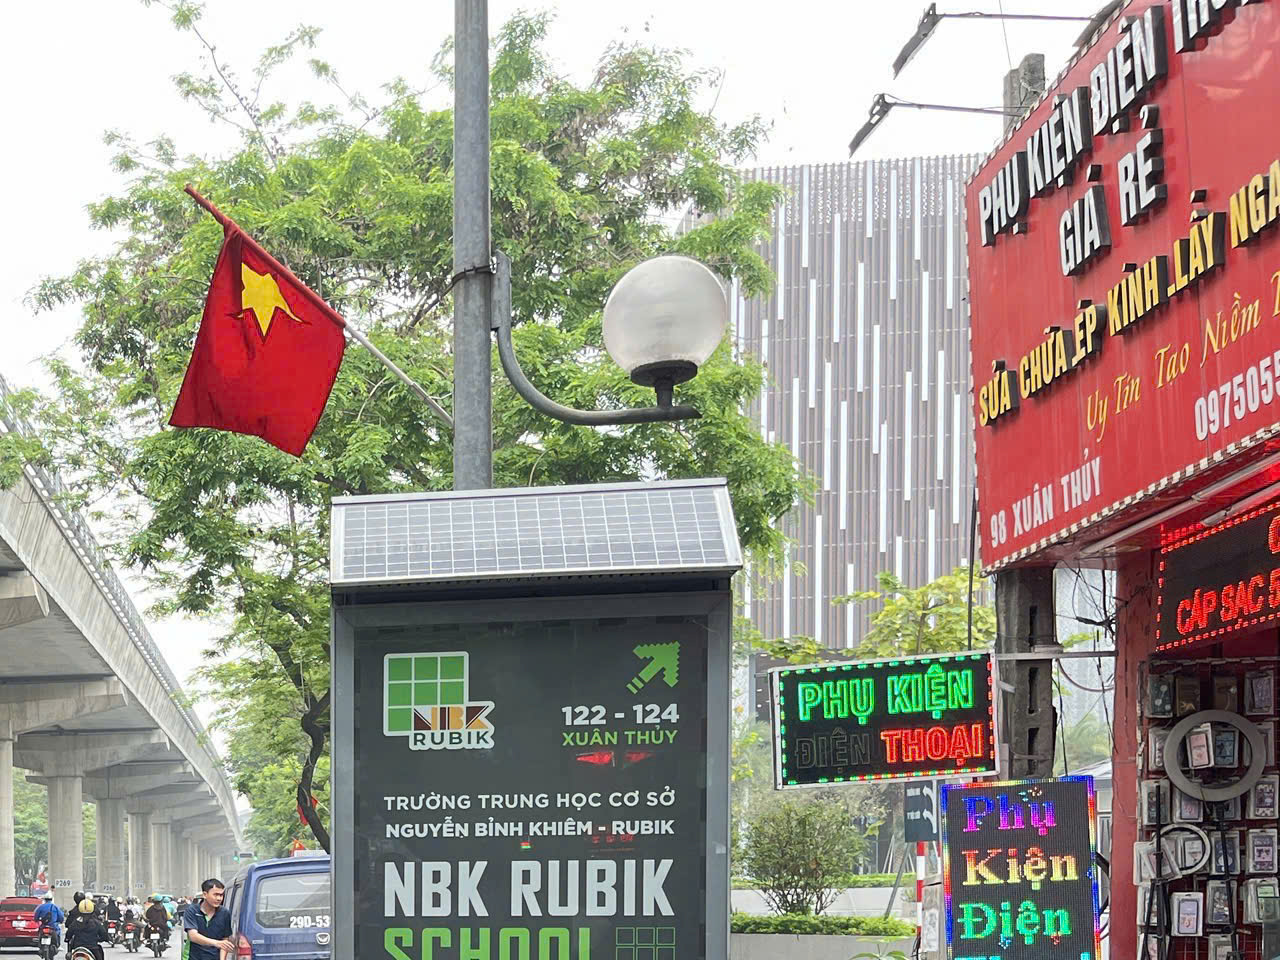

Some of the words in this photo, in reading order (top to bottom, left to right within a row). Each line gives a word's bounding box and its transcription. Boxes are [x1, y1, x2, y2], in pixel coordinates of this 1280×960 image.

[979, 153, 1020, 247] PHỤ
[1026, 86, 1087, 199] KIỆN
[1090, 5, 1157, 136] ĐIỆN
[1059, 165, 1101, 276] GIÁ
[1118, 104, 1157, 227] RẺ
[979, 361, 1012, 427] SỬA
[1020, 328, 1067, 399] CHỮA
[1108, 256, 1160, 336] KÍNH
[1087, 391, 1108, 443] Uy
[1114, 371, 1141, 415] Tín
[1155, 342, 1190, 389] Tạo
[1200, 292, 1261, 368] Niềm
[990, 510, 1007, 549] 98
[1012, 483, 1054, 538] XUÂN
[1061, 448, 1101, 512] THỦY
[1176, 589, 1217, 635] CÁP
[562, 705, 606, 726] 122
[632, 704, 679, 725] 124
[798, 678, 875, 726] PHỤ
[887, 664, 973, 720] KIỆN
[414, 731, 489, 745] RUBIK
[563, 729, 618, 746] XUÂN
[625, 725, 678, 745] THỦY
[795, 727, 871, 773] ĐIỆN
[880, 724, 984, 766] THOẠI
[384, 792, 471, 810] TRƯỜNG
[478, 794, 549, 809] TRUNG
[557, 793, 602, 811] HỌC
[609, 791, 640, 807] CƠ
[647, 785, 676, 807] SỞ
[962, 794, 1057, 836] Phụ
[385, 816, 469, 838] NGUYỄN
[529, 817, 593, 837] KHIÊM
[612, 819, 675, 836] RUBIK
[56, 879, 71, 887] P269
[384, 860, 489, 917] NBK
[511, 859, 675, 917] RUBIK
[962, 848, 1078, 890] Kiện
[958, 900, 1072, 945] Điện
